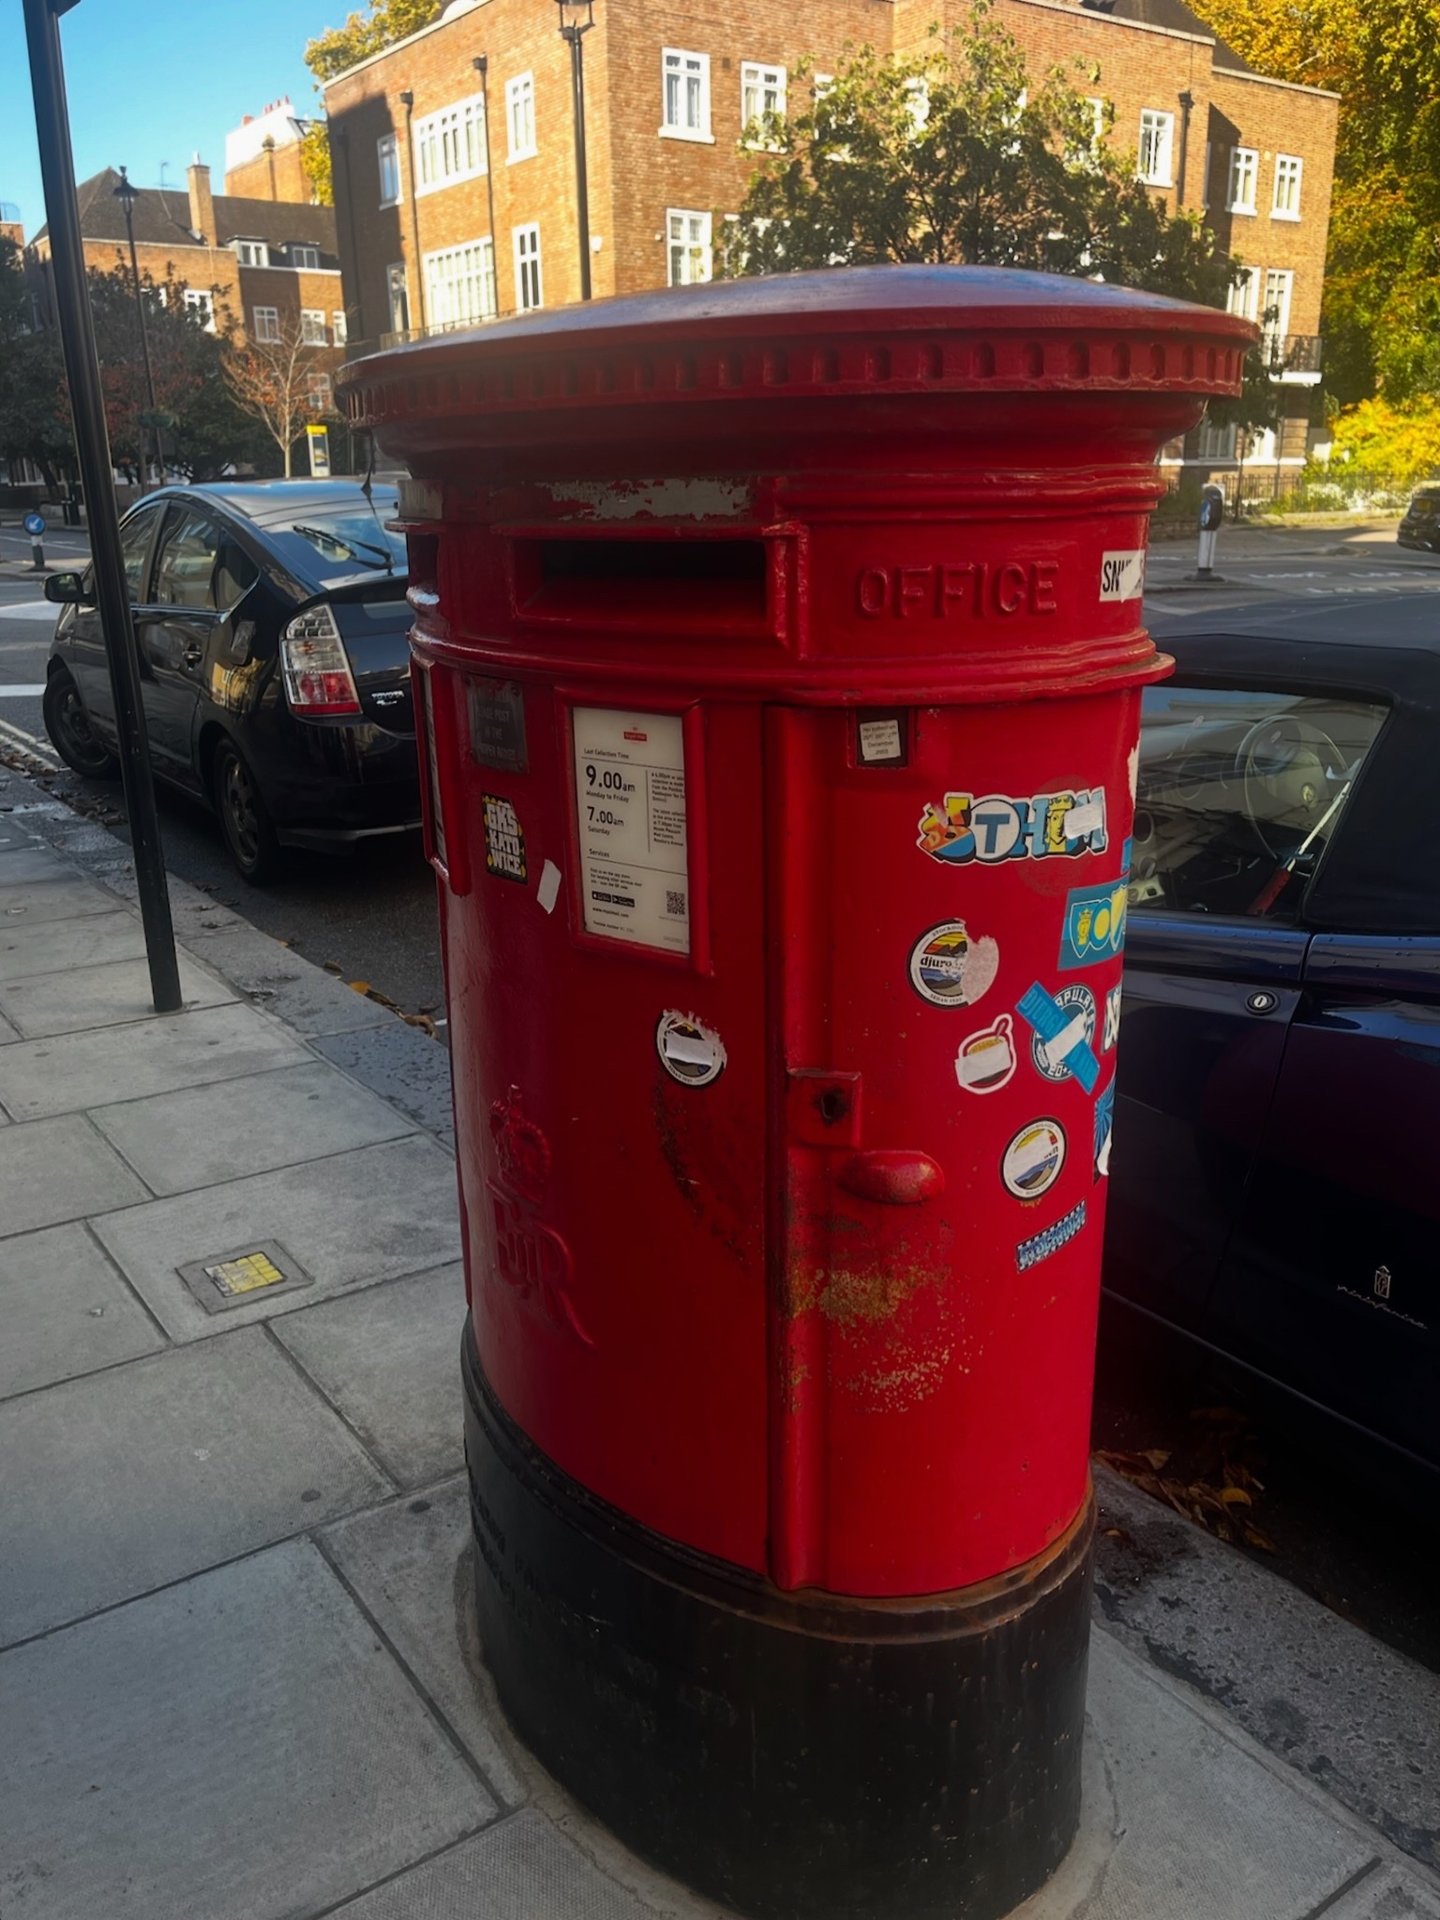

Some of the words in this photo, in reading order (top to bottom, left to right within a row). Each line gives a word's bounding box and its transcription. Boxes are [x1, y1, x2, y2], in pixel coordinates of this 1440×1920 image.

[857, 559, 1059, 619] OFFICE
[371, 690, 405, 700] TOYOTA
[585, 764, 635, 792] 9.00am
[586, 790, 606, 800] Monday
[613, 794, 630, 803] Friday
[486, 803, 518, 837] GKS
[587, 806, 624, 826] 7.00am
[488, 829, 520, 856] KATO
[588, 826, 610, 836] Saturday
[491, 848, 522, 875] WICE
[589, 848, 610, 858] Services
